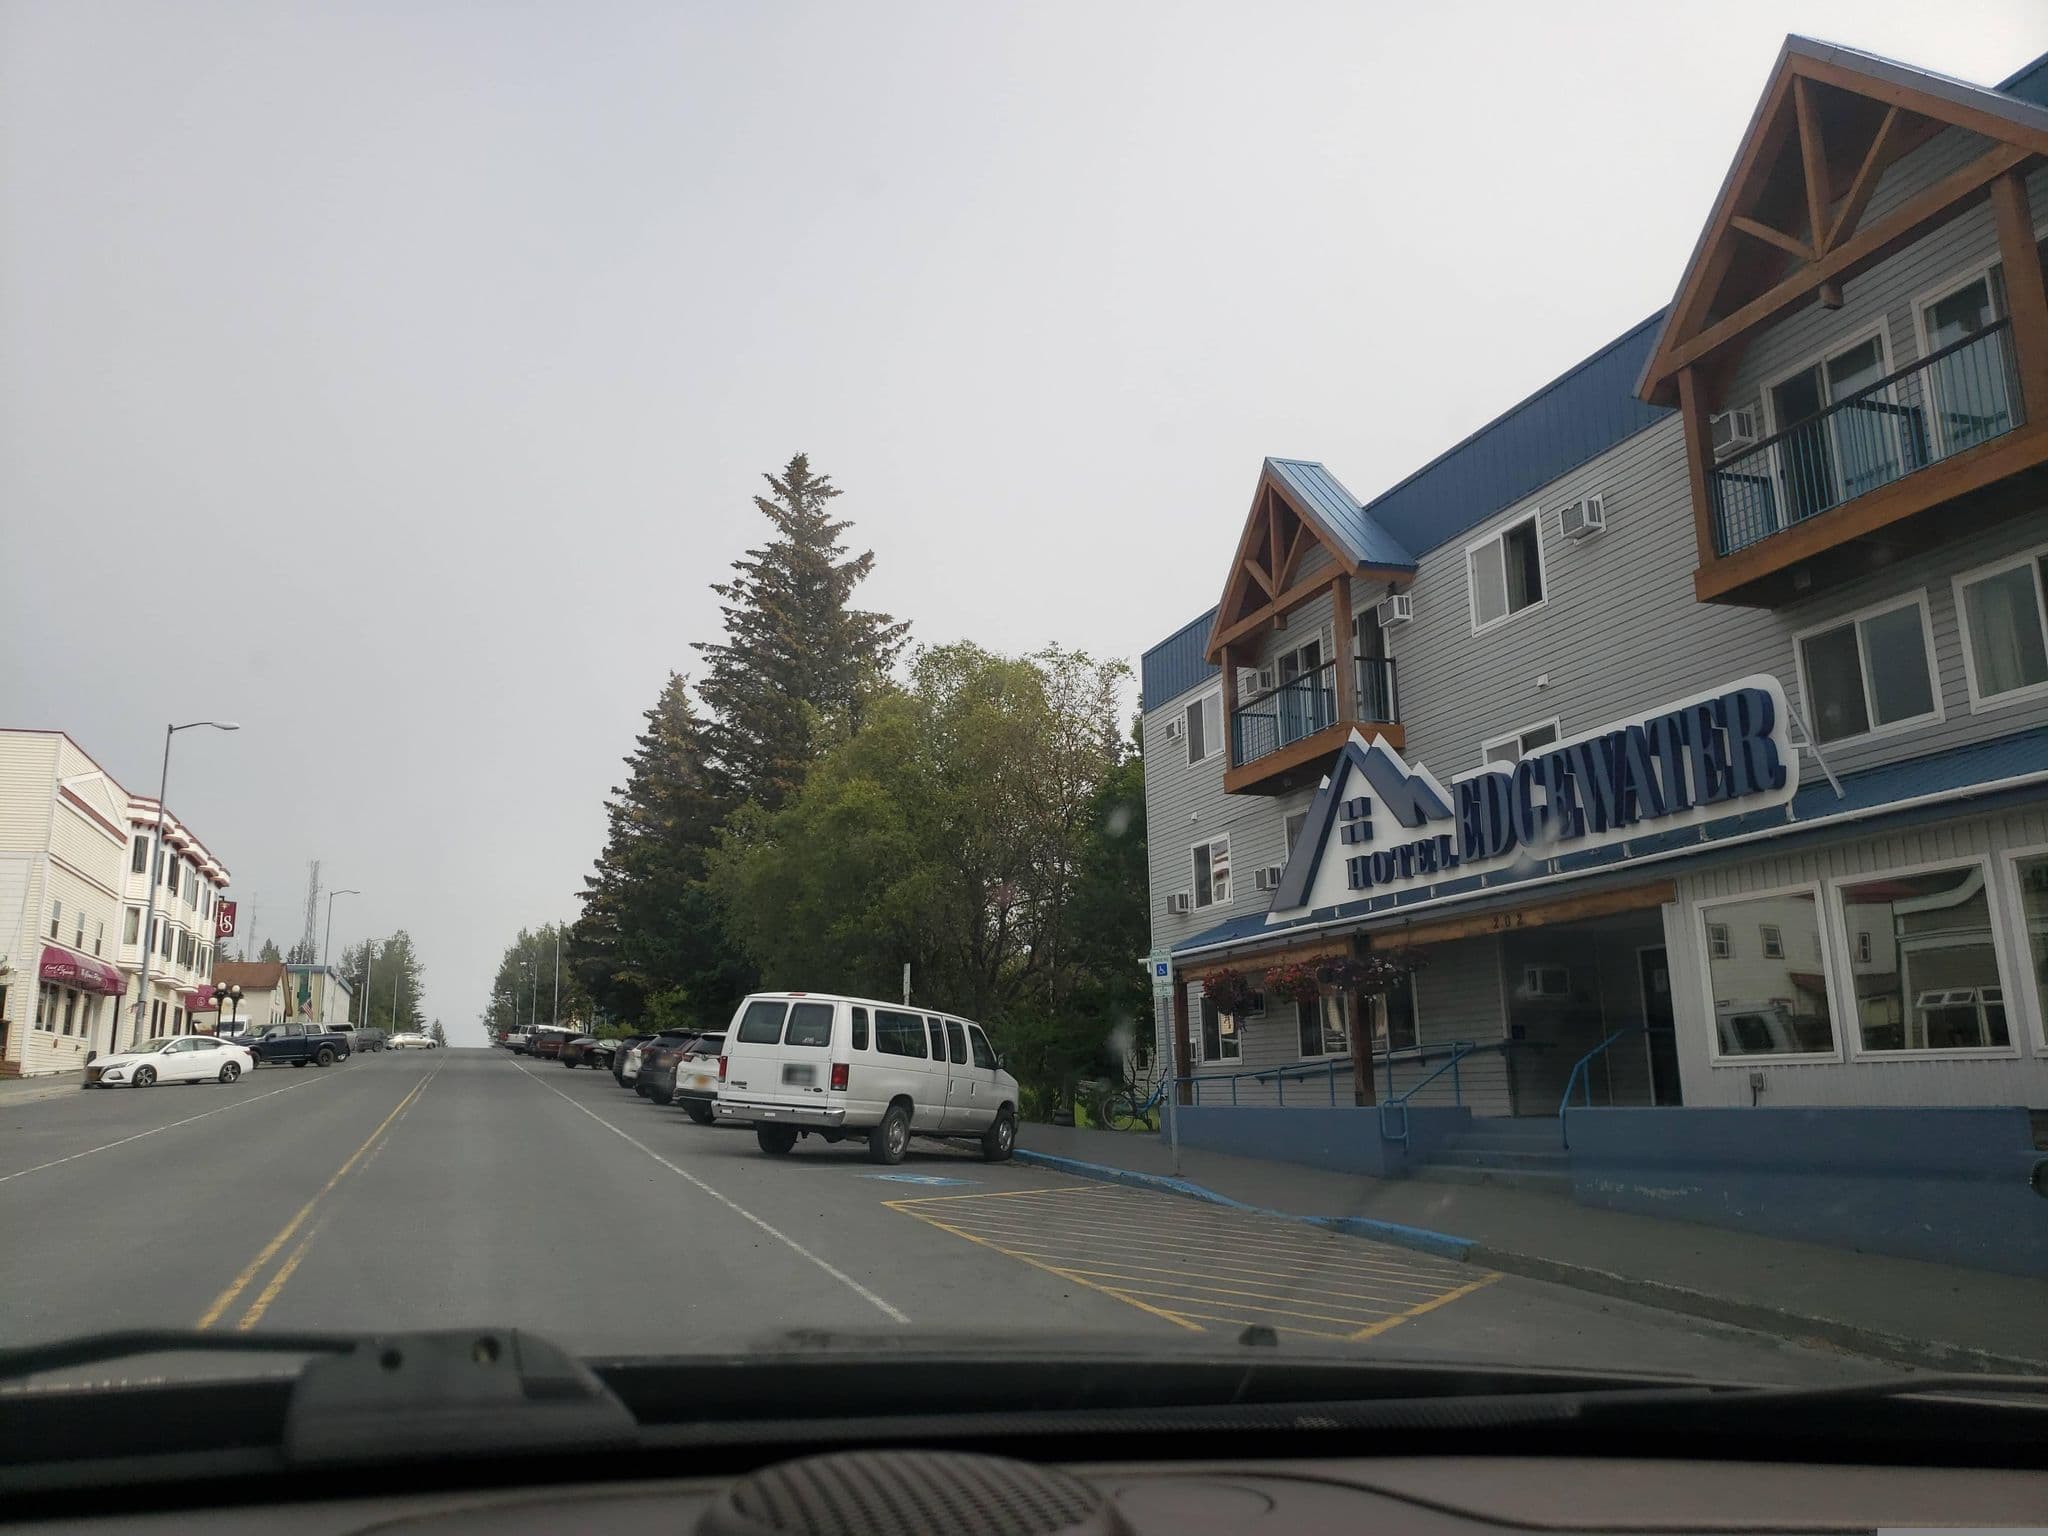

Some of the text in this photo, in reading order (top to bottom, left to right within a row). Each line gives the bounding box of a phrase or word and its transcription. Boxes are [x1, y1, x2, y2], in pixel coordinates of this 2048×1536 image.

[1345, 687, 1787, 890] HOTEL EDGEWATER
[1493, 913, 1524, 929] 202
